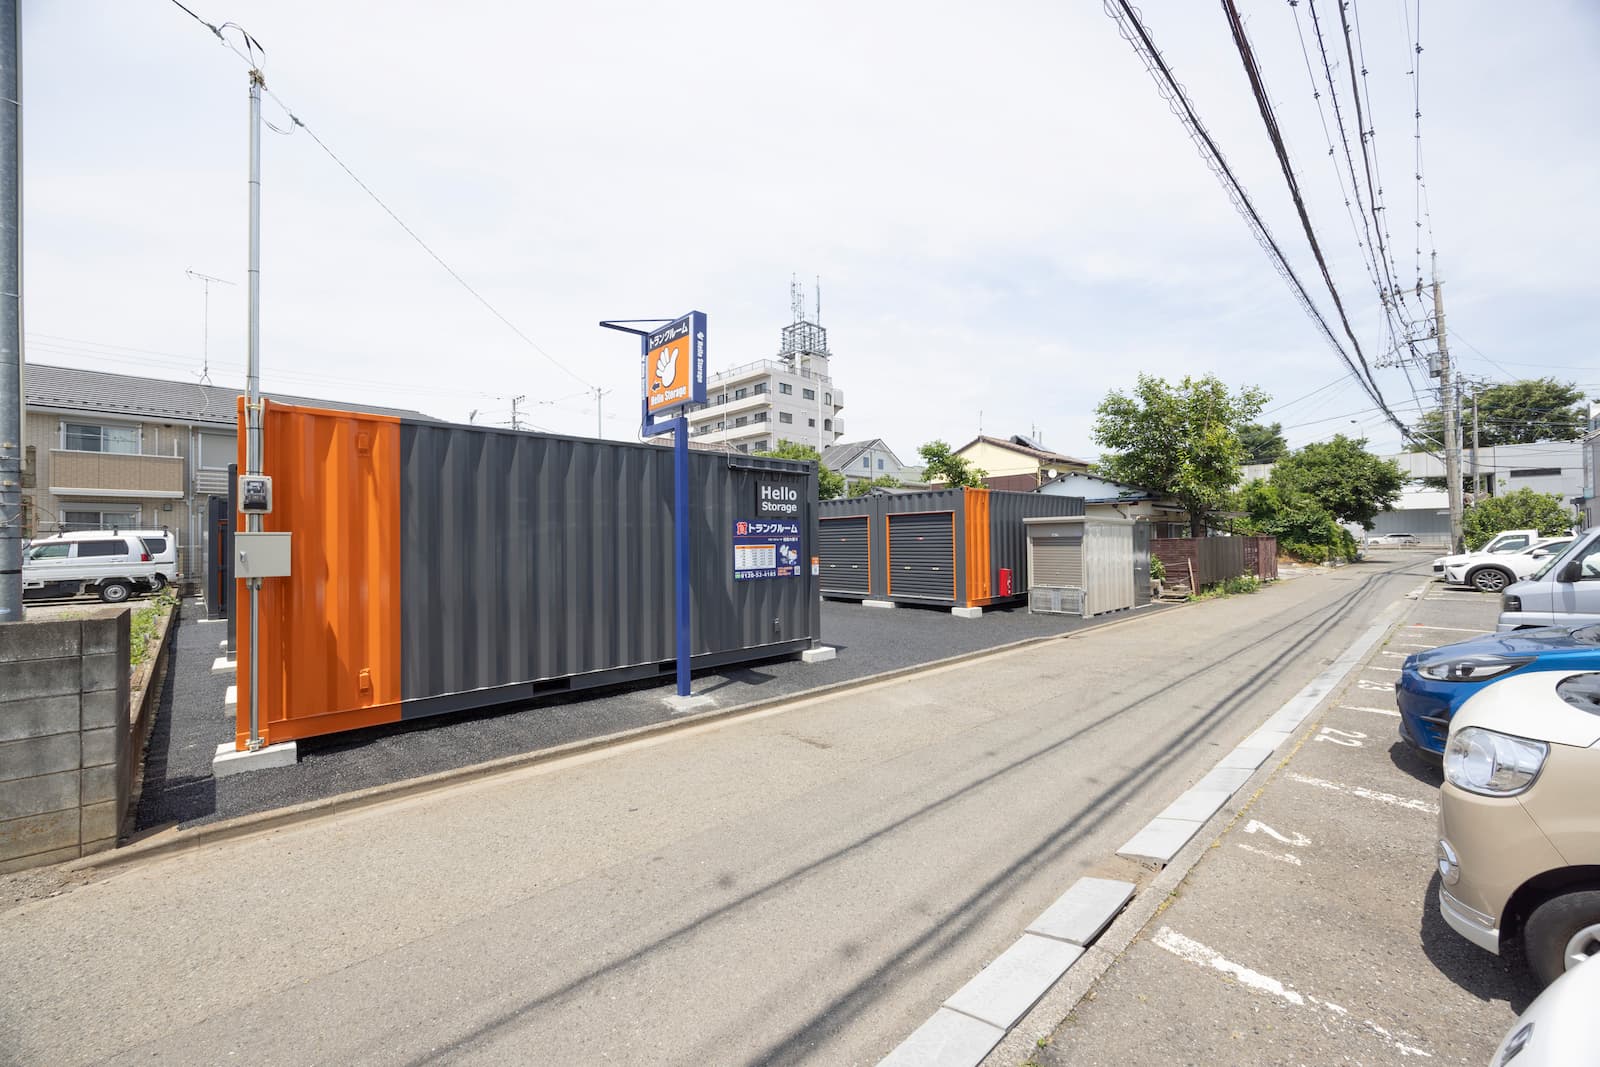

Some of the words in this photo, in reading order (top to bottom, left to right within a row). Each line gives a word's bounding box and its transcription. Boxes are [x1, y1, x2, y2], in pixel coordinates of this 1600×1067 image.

[650, 323, 688, 349] トランクルーム
[665, 386, 686, 400] Storage
[761, 486, 797, 500] Hello
[762, 502, 797, 513] Storage
[748, 523, 798, 533] トランクルーム
[1315, 728, 1366, 746] 22
